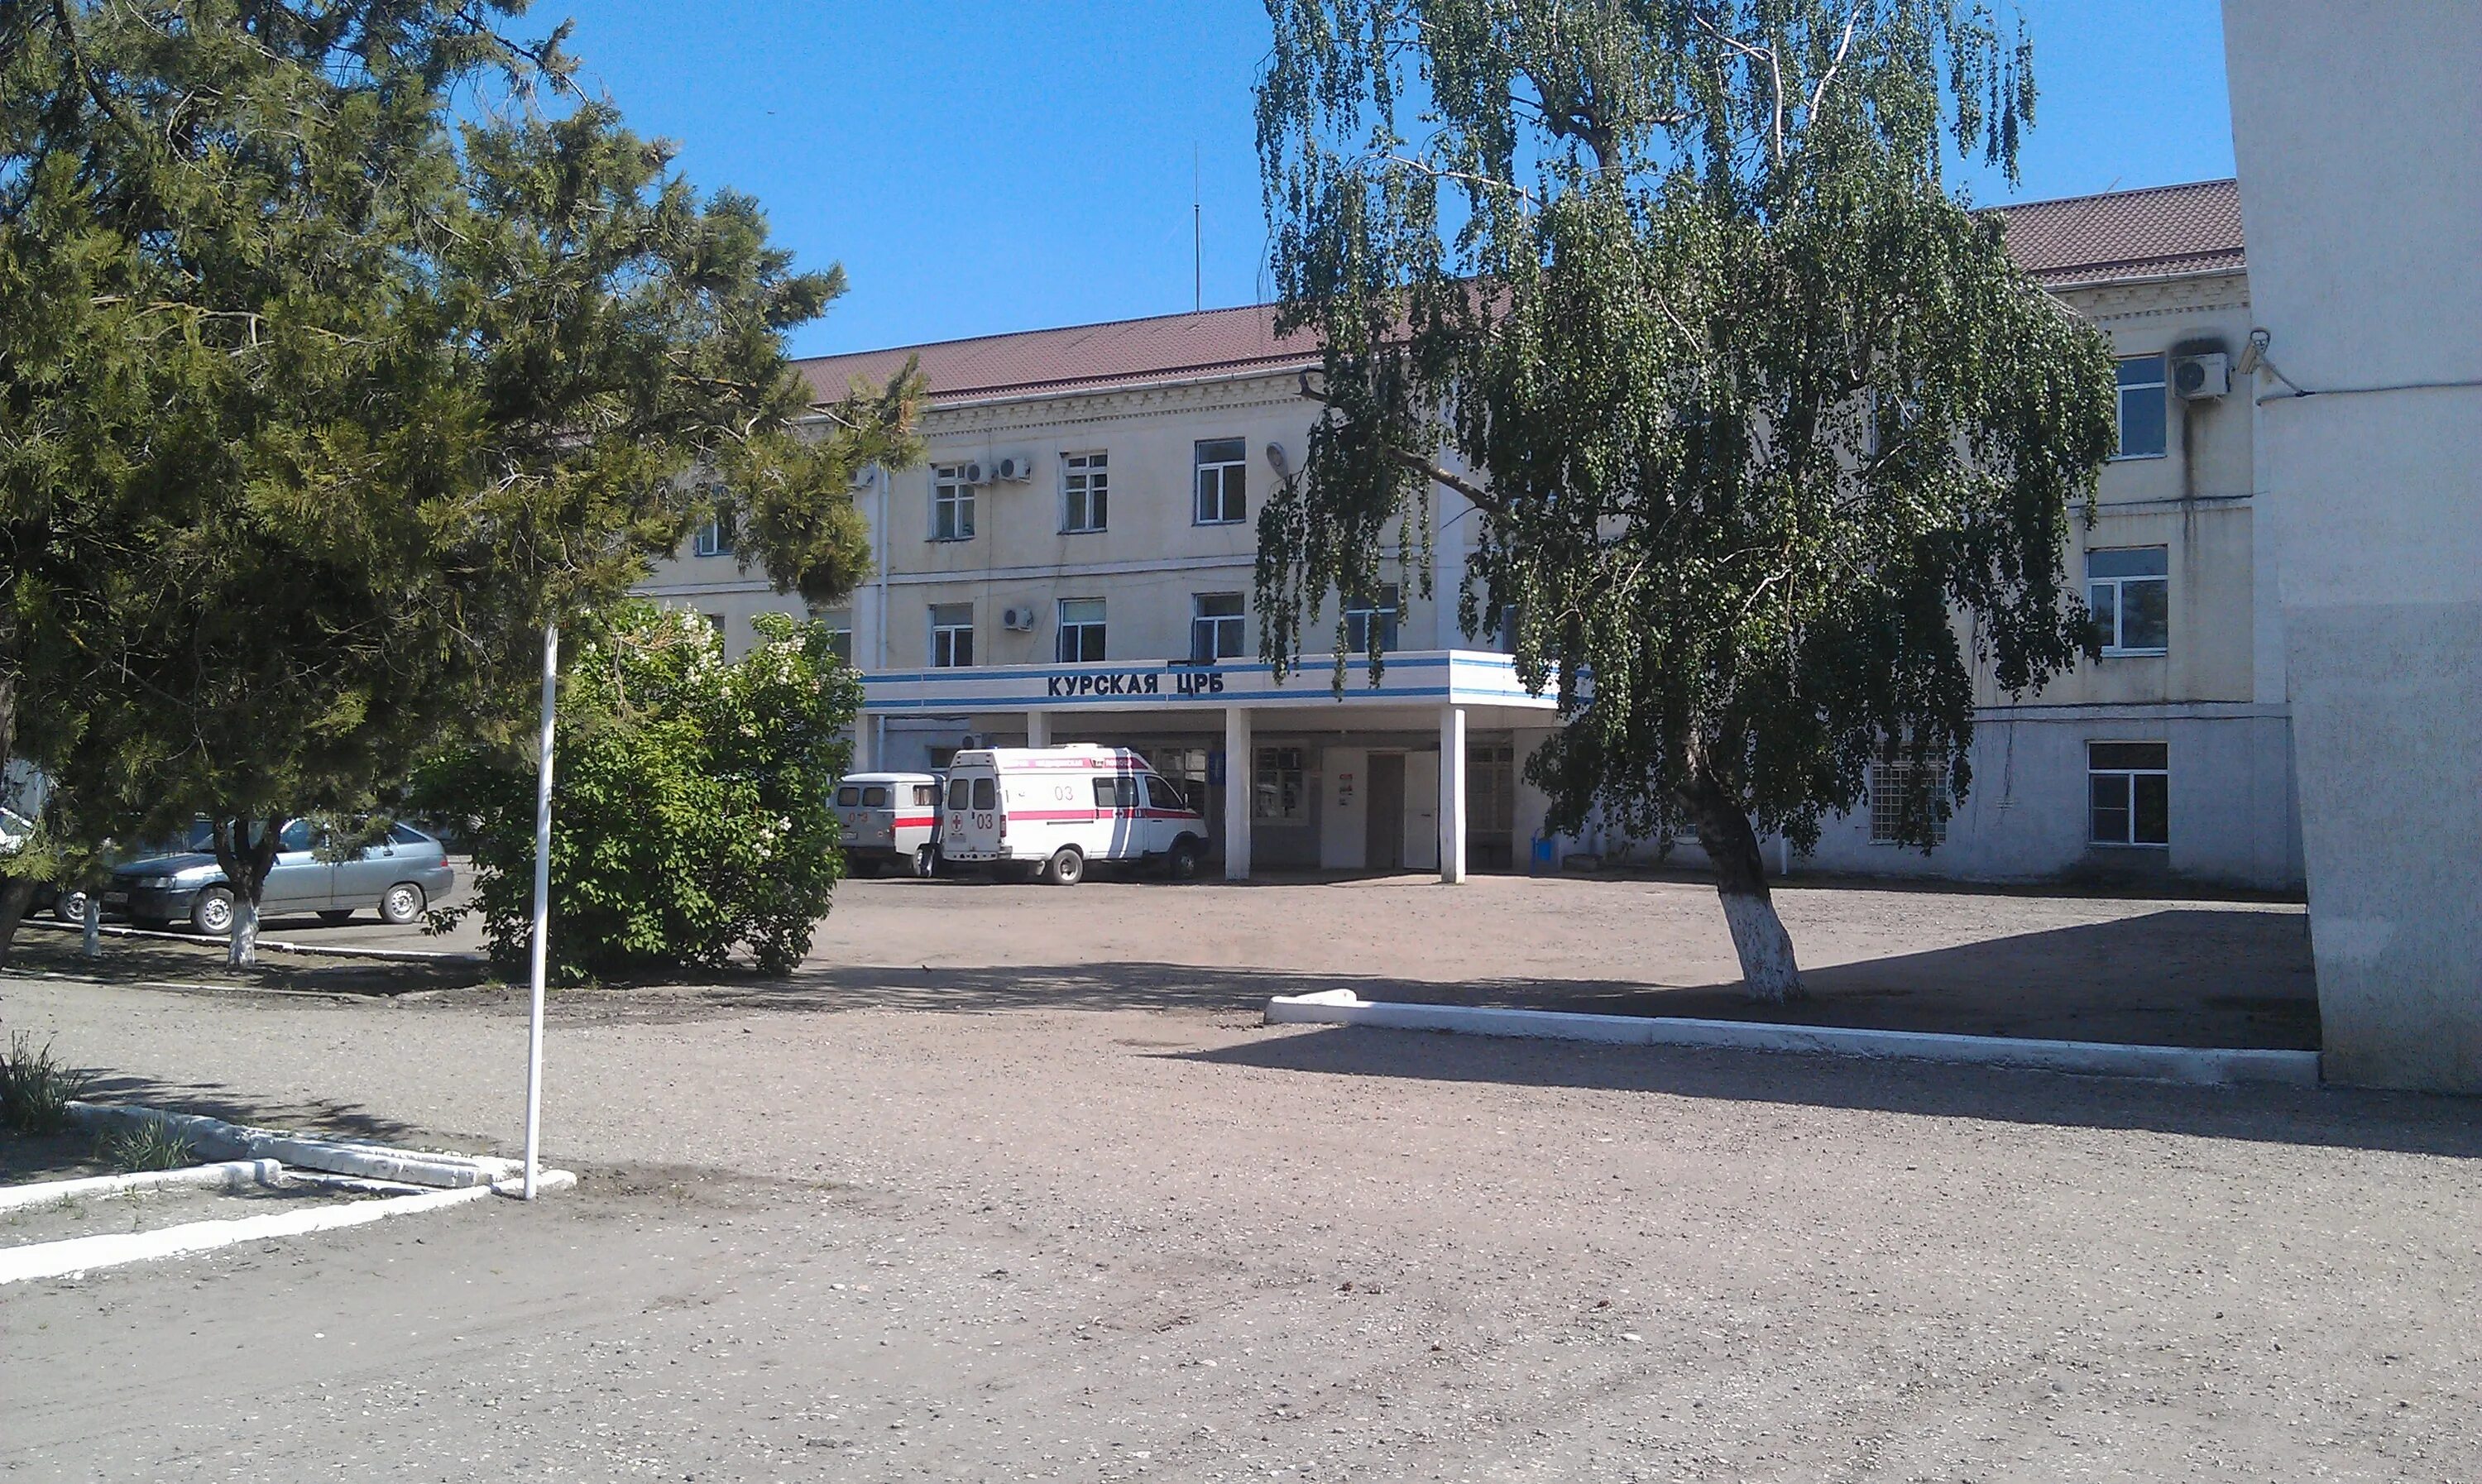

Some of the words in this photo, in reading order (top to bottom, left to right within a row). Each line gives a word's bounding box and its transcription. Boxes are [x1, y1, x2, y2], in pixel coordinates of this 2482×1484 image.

[1048, 674, 1158, 697] КУРСКАЯ
[1176, 673, 1224, 697] ЦРБ
[1054, 786, 1073, 801] 03
[976, 813, 993, 830] 03
